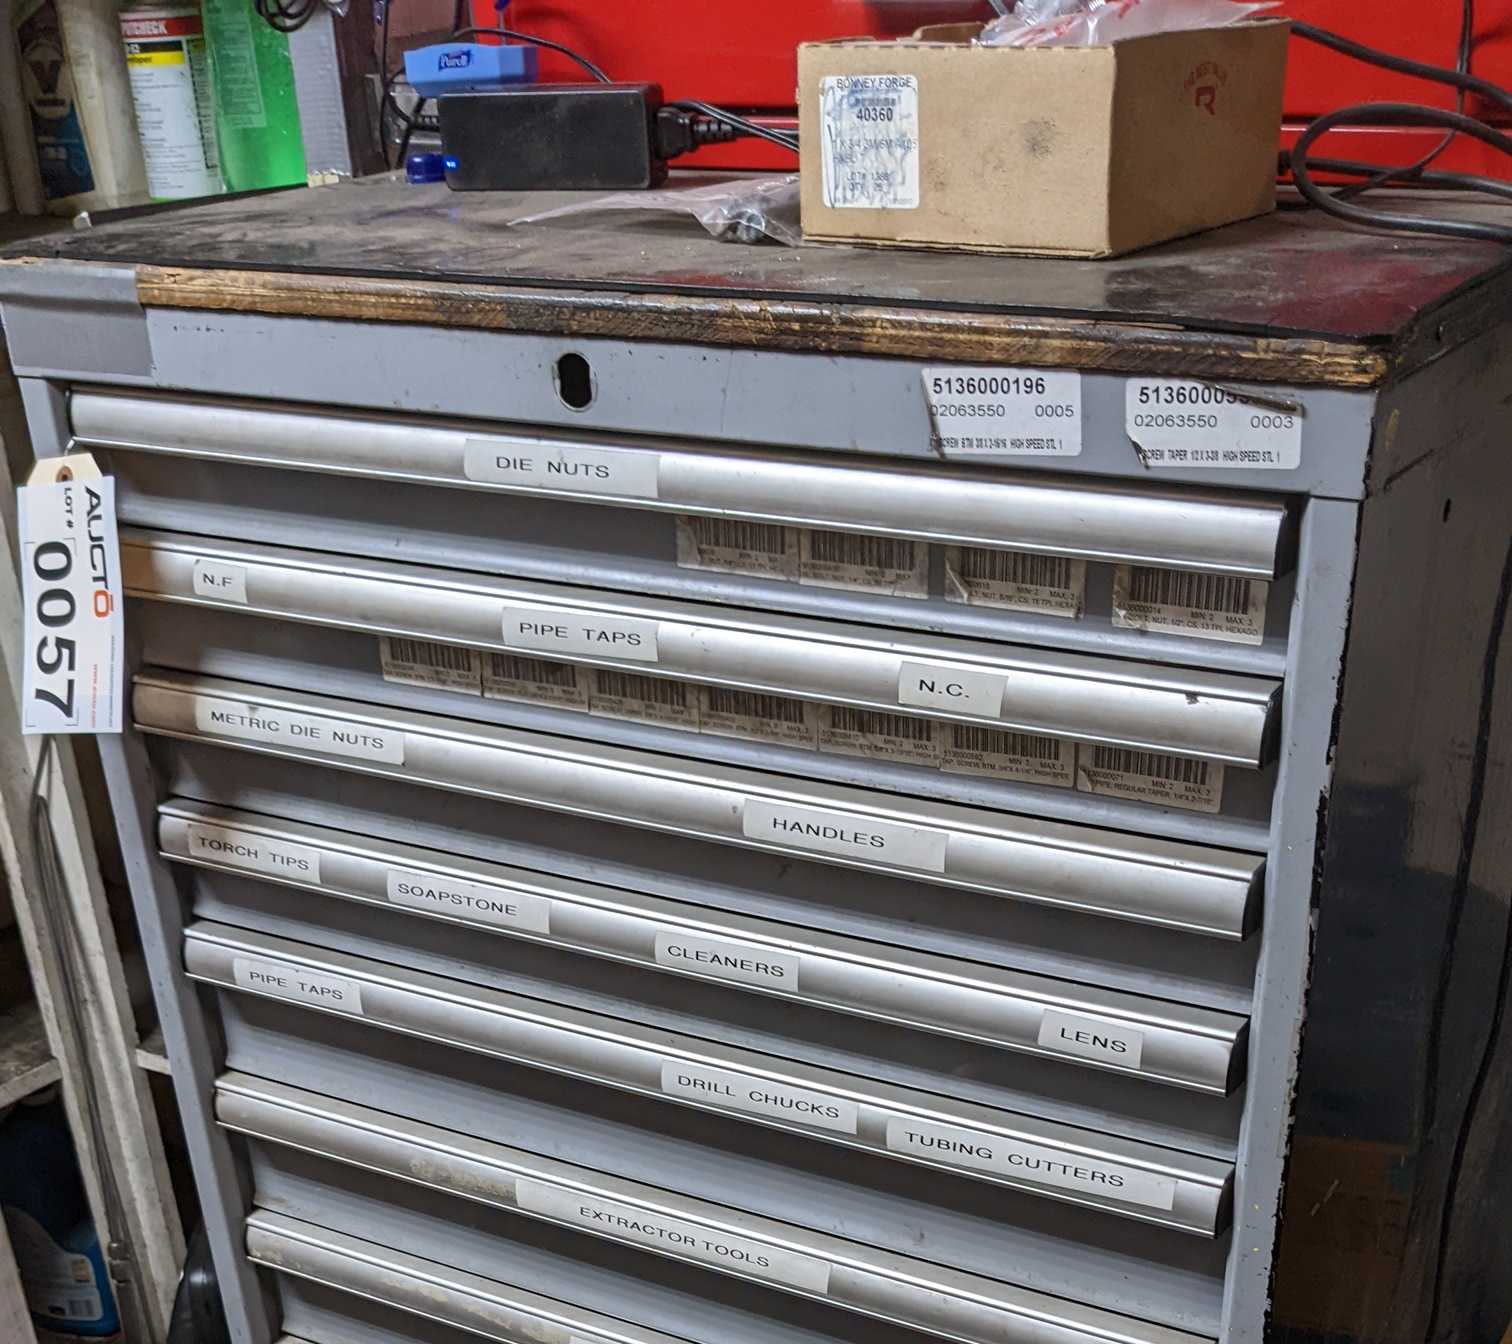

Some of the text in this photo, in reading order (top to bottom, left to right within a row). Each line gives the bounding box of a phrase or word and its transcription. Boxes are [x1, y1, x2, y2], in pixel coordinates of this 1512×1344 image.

[880, 77, 912, 88] FORGE
[856, 107, 894, 122] 40360
[933, 377, 1046, 395] 5136000196
[931, 404, 1074, 418] 02063550 0005
[1134, 414, 1294, 429] 02063550 0003
[496, 456, 609, 478] DIE NUTS
[64, 487, 73, 515] LOT
[203, 573, 232, 587] N.F
[33, 540, 76, 719] 0057
[519, 622, 641, 646] PIPE TAPS
[919, 679, 970, 698] N.C.
[211, 711, 384, 749] METRIC DIE NUTS
[773, 817, 885, 848] HANDLES
[198, 836, 309, 871] TORCH TIPS
[398, 883, 518, 916] SOAPSTONE
[667, 945, 784, 977] CLEANERS
[249, 971, 343, 1000] PIPE TAPS
[1060, 1027, 1127, 1053] LENS
[677, 1075, 839, 1119] DRILL CHUCKS
[904, 1131, 1124, 1187] TUBING CUTTERS
[579, 1206, 769, 1268] EXTRACTOR TOOLS
